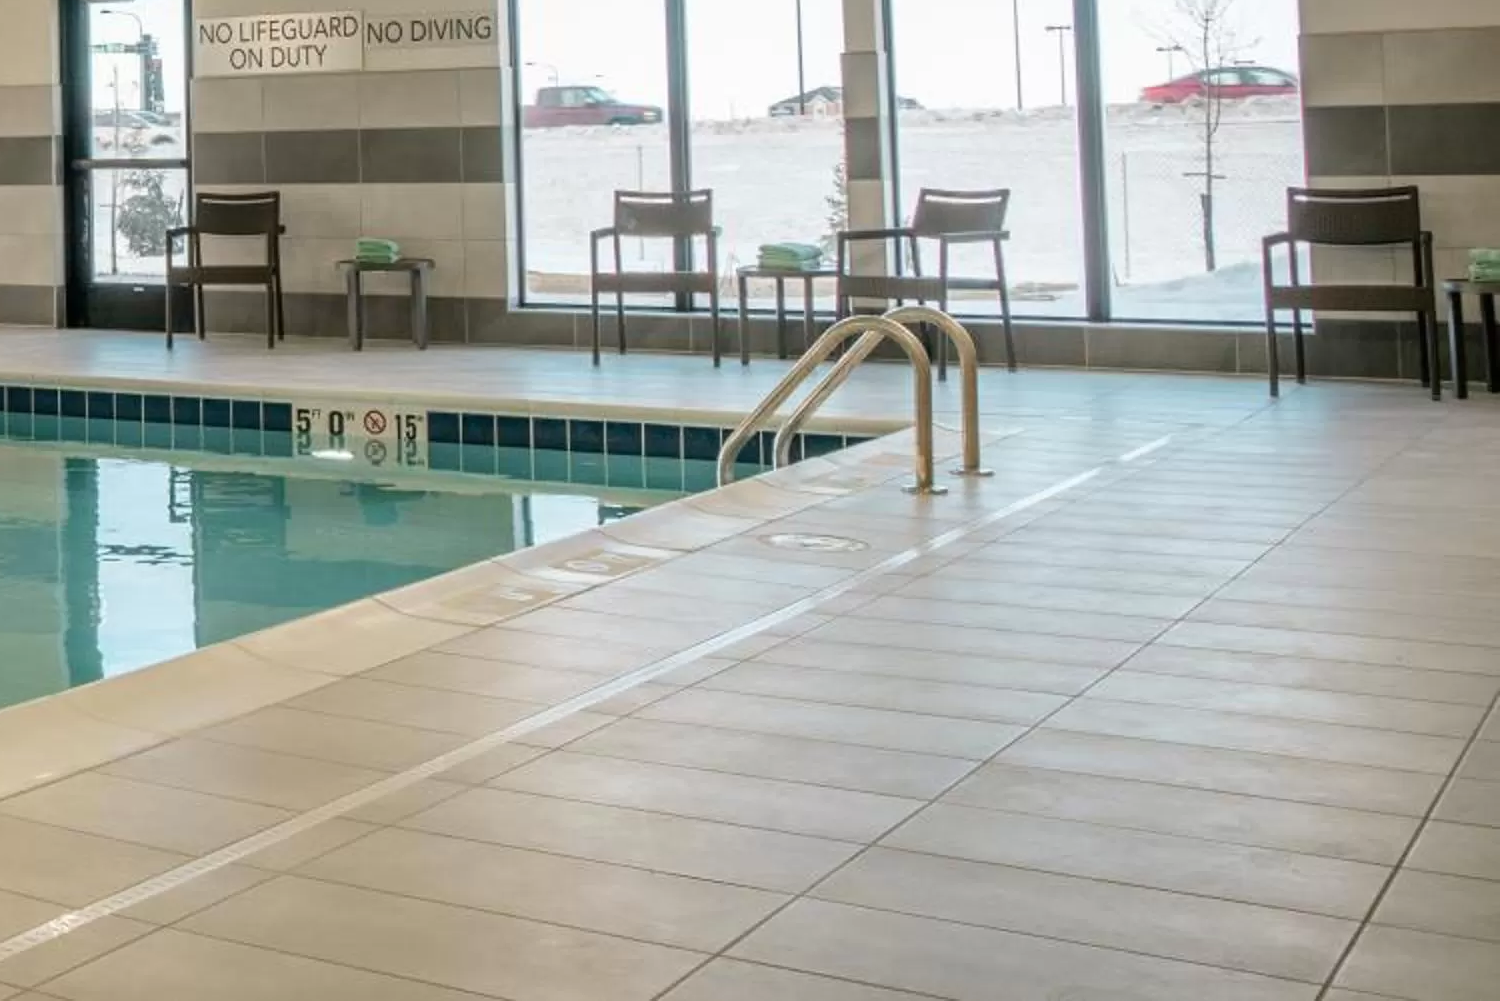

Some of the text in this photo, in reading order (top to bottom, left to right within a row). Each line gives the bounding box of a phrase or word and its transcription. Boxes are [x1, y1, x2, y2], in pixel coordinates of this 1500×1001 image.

[199, 15, 359, 45] NO LIFEGUARD
[366, 16, 492, 44] NO DIVING
[229, 44, 327, 70] ON DUTY
